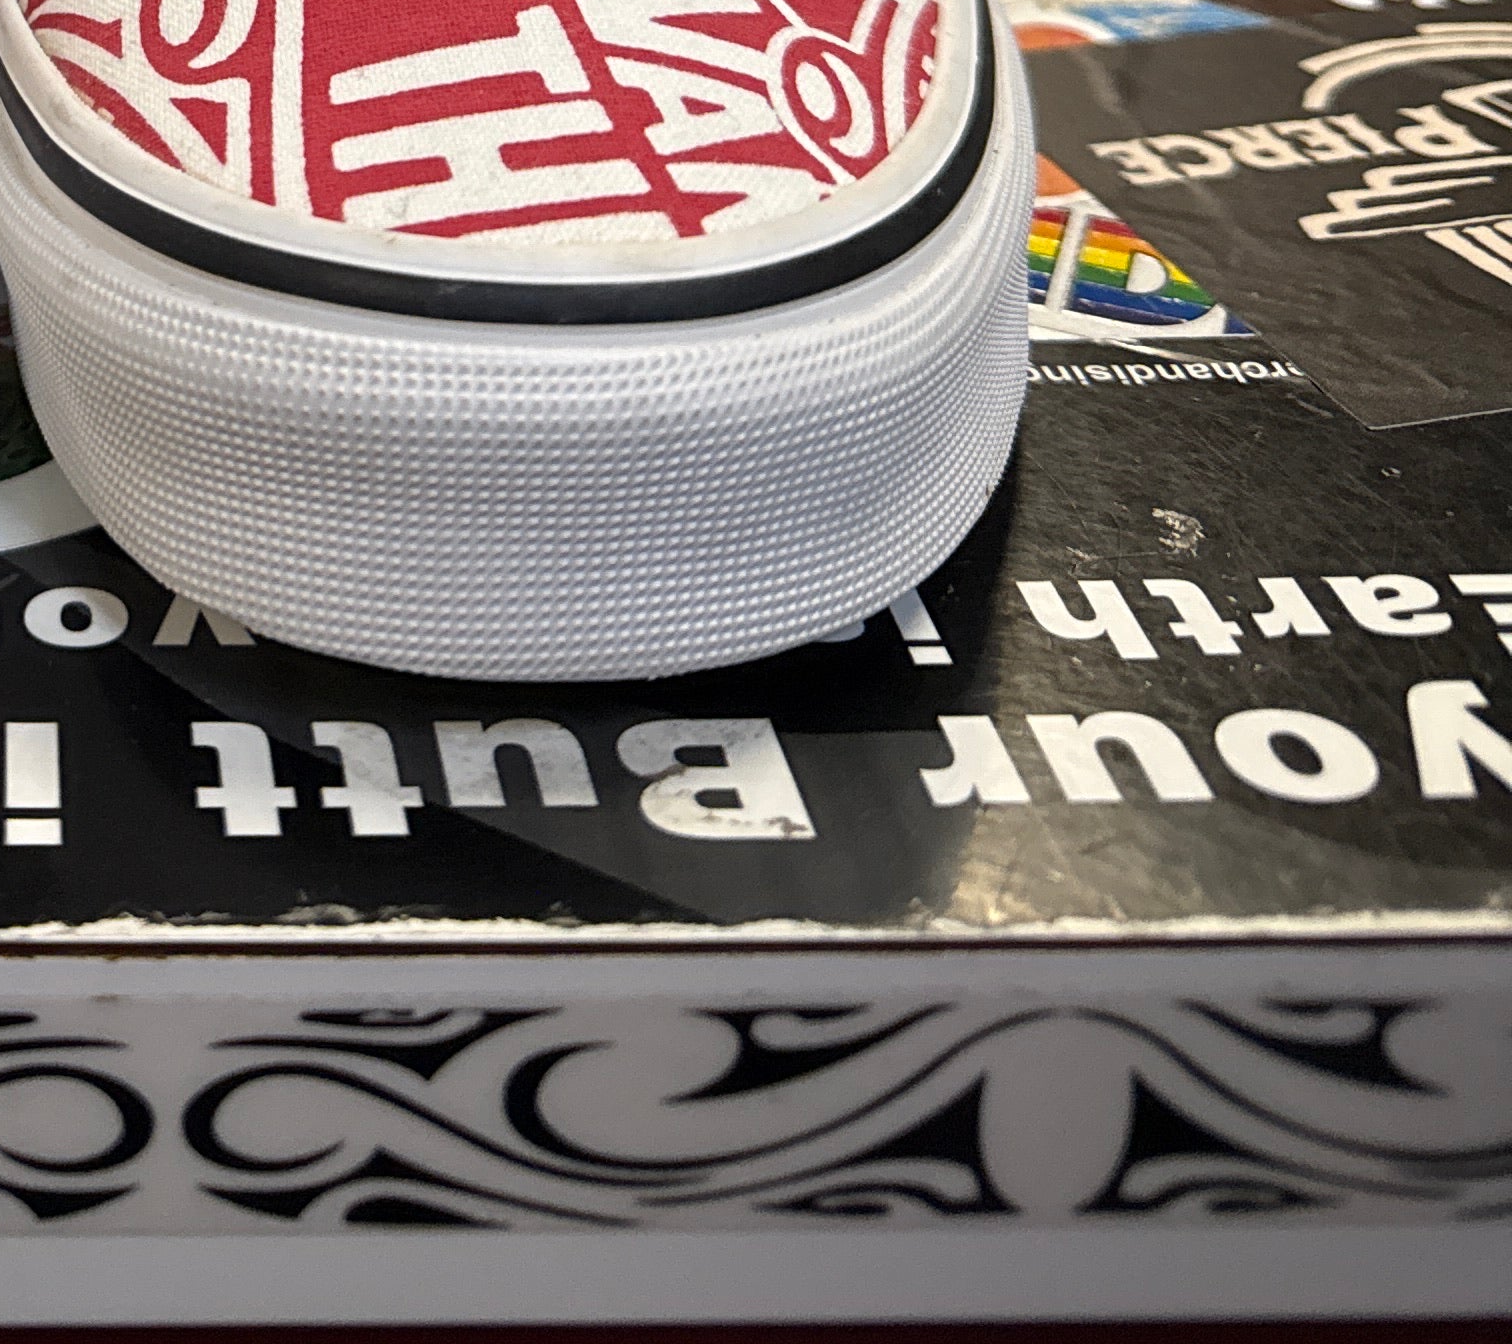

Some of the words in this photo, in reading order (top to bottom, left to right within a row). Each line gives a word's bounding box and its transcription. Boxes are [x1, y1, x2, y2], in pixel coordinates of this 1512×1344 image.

[1090, 105, 1499, 187] PIERCE
[191, 718, 818, 841] Butt
[920, 680, 1512, 804] your
